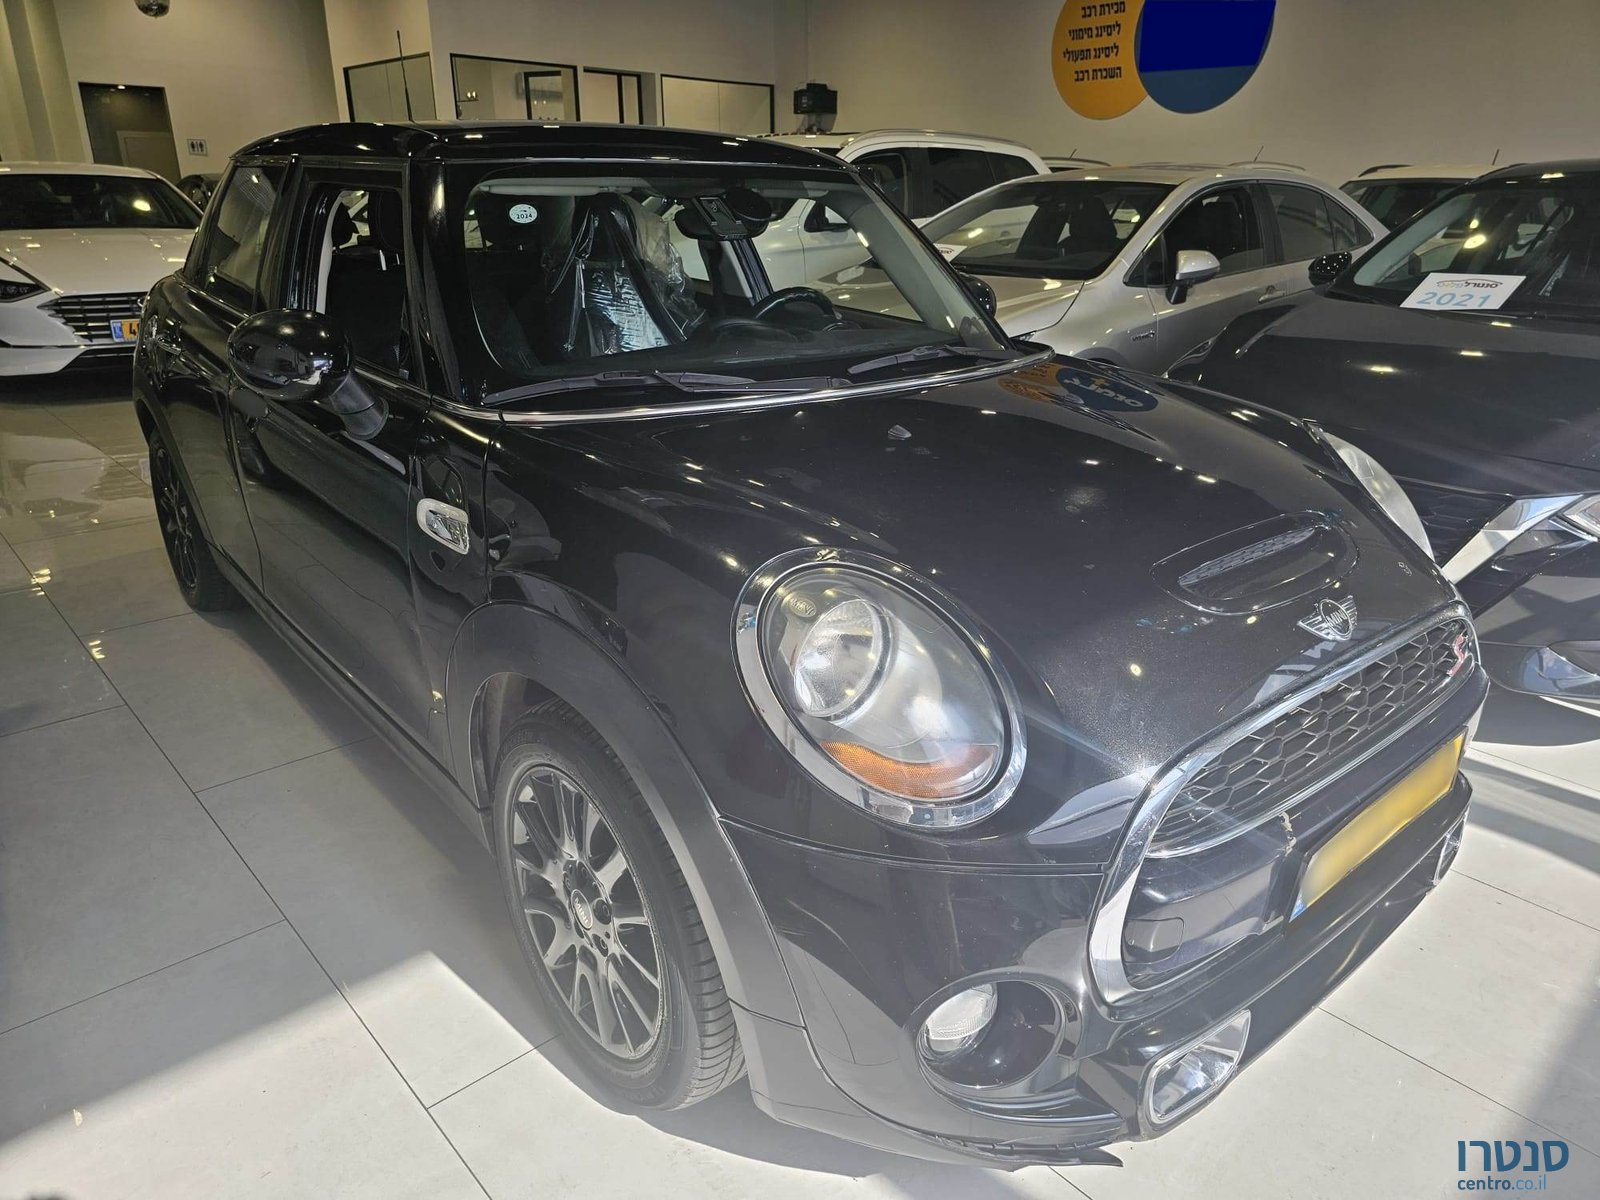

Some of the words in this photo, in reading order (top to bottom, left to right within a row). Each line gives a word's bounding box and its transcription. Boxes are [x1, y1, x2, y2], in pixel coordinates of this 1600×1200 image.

[1081, 4, 1097, 18] רכב
[1099, 1, 1126, 16] מכירת
[1068, 26, 1093, 41] מימוני
[1095, 21, 1121, 38] ליסינג
[1063, 47, 1091, 63] תפעולי
[1093, 42, 1119, 59] ליסינג
[1074, 69, 1090, 82] רכב
[1092, 66, 1122, 80] השכרת
[1416, 291, 1491, 307] 2021
[1326, 609, 1348, 627] MINI
[574, 897, 589, 924] MINI
